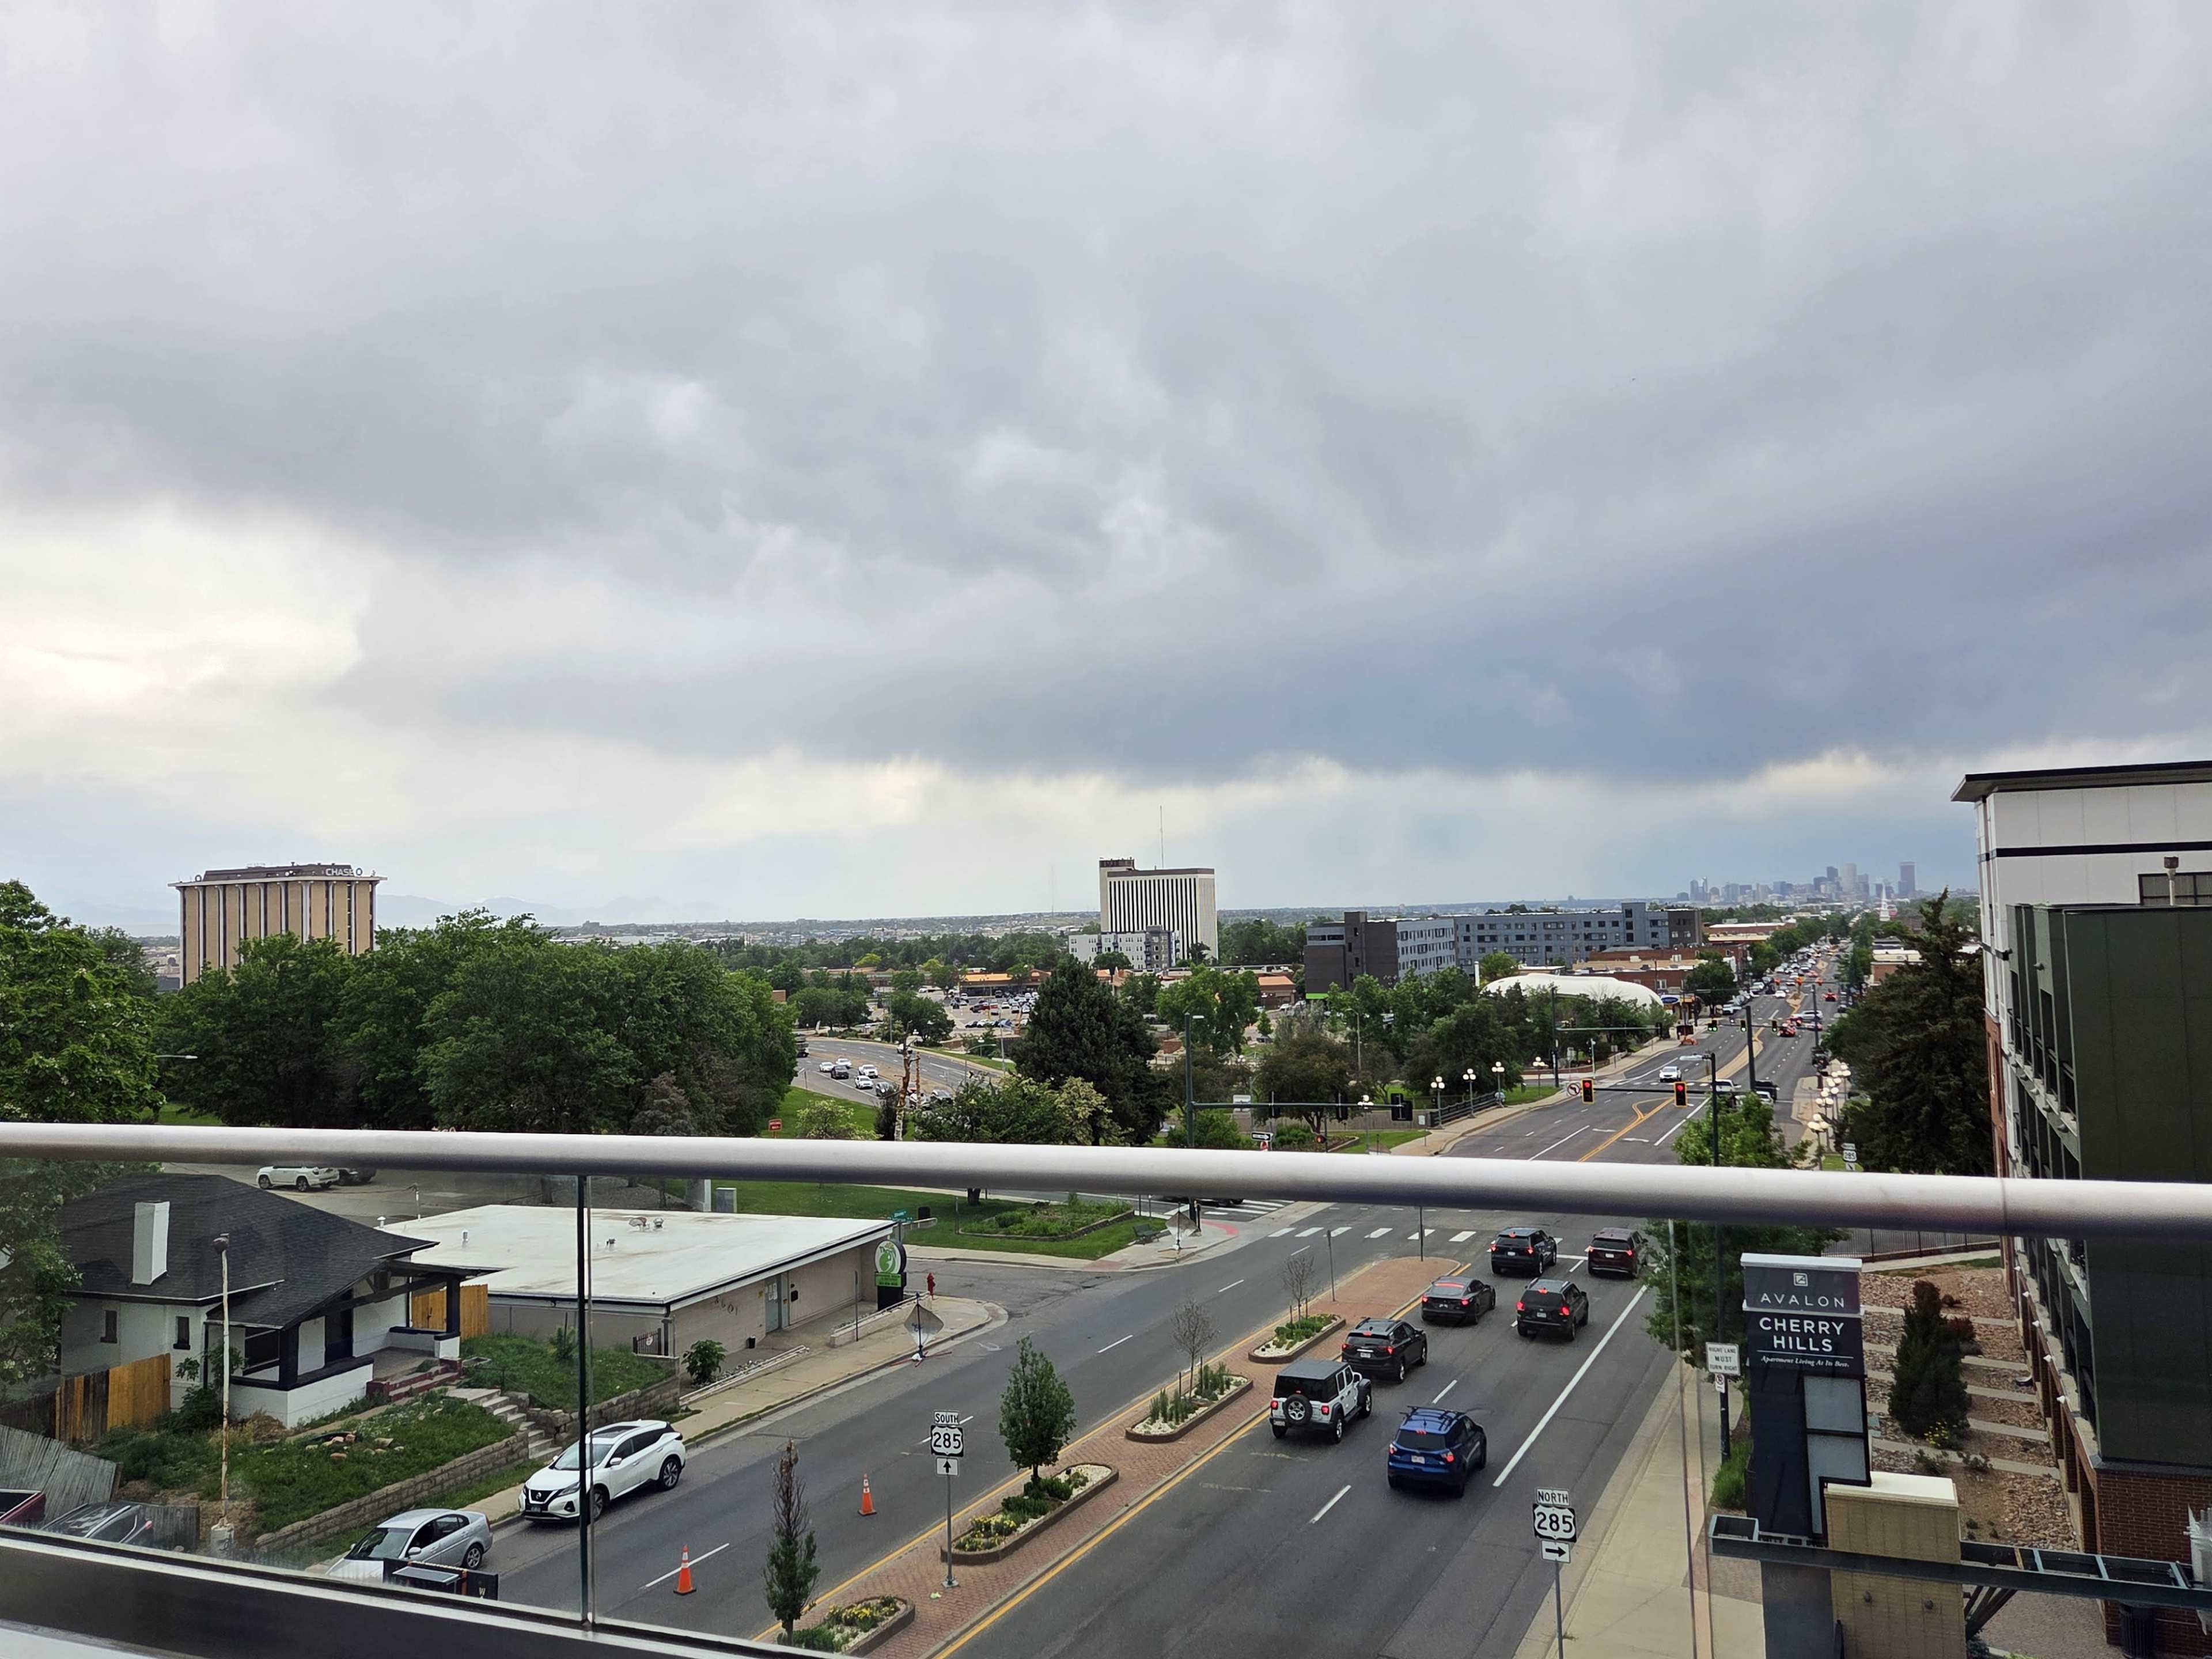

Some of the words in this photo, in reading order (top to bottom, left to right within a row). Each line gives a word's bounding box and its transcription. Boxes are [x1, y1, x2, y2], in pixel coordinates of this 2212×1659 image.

[1760, 1293, 1844, 1308] AVALON
[1759, 1317, 1844, 1335] CHERRY
[1773, 1335, 1832, 1352] HILLS
[1761, 1355, 1794, 1364] Apartment
[1795, 1358, 1815, 1366] Living
[935, 1413, 959, 1423] SOUTH
[933, 1432, 961, 1449] 285
[1538, 1490, 1569, 1503] NORTH
[1536, 1512, 1573, 1533] 285
